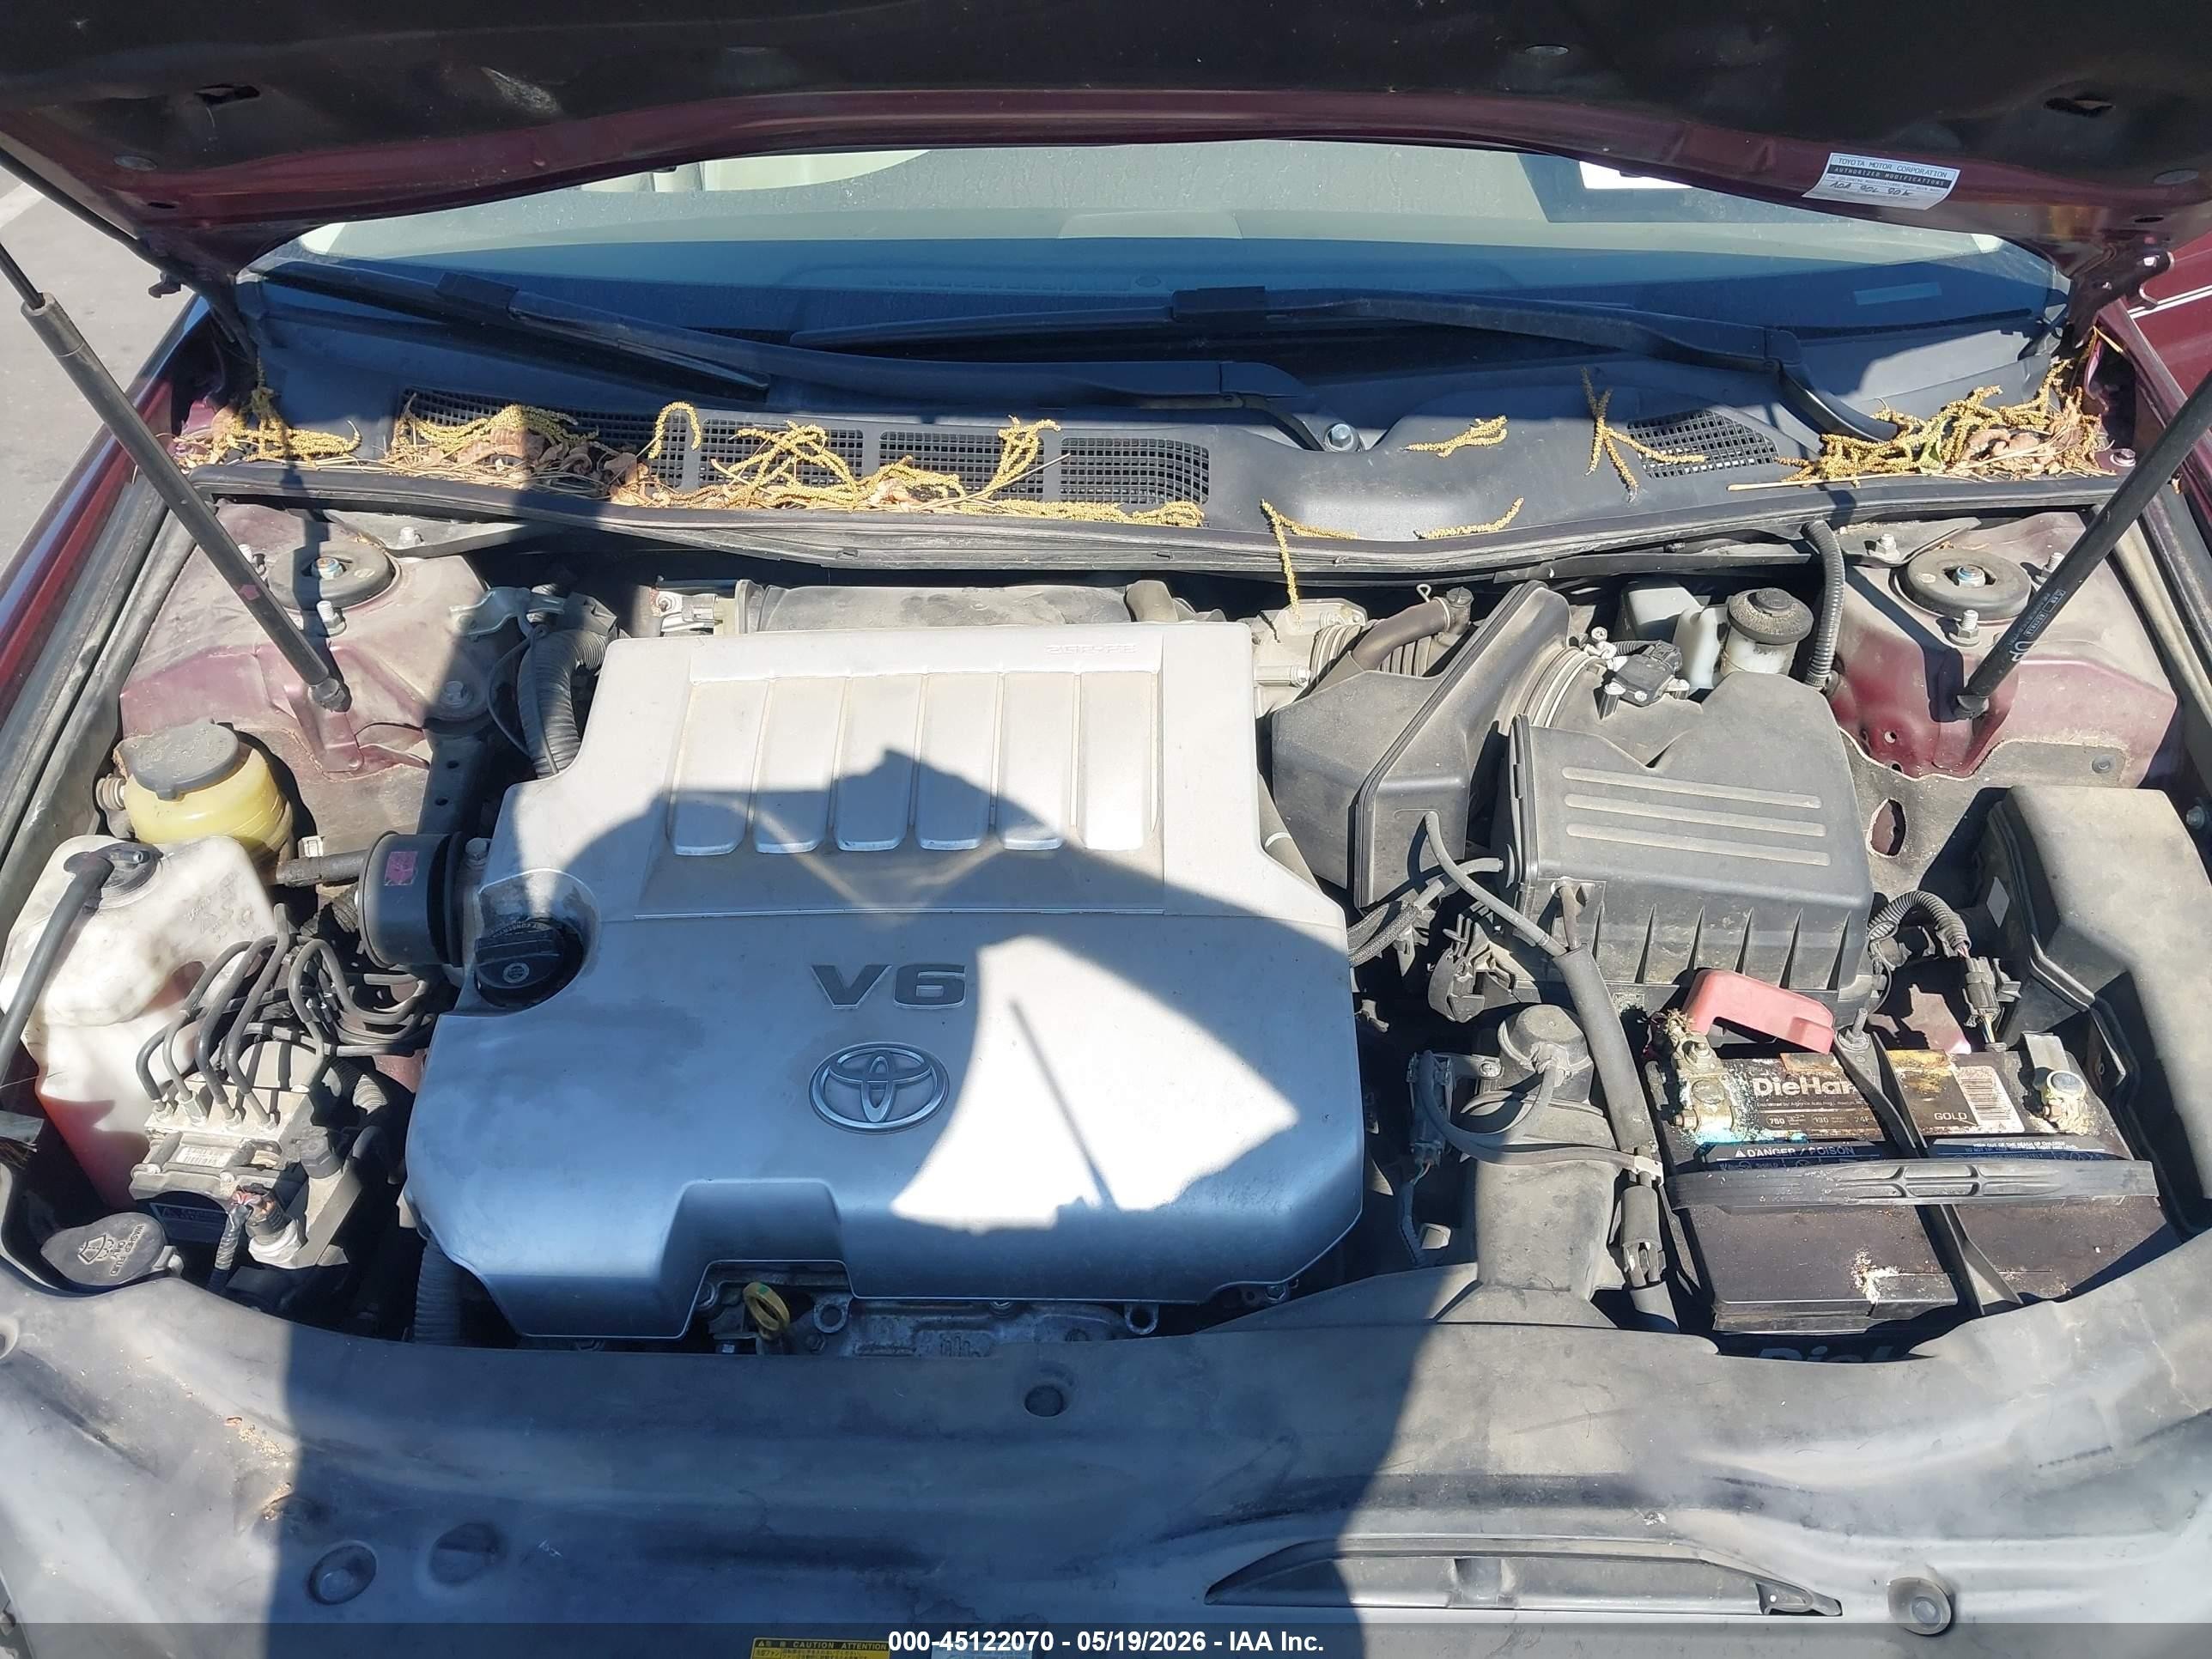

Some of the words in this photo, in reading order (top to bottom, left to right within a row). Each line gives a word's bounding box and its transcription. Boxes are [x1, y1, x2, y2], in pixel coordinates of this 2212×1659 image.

[1834, 167, 1881, 177] AUTHORIZED
[1884, 173, 1945, 186] MODIFICATIONS
[1838, 158, 1865, 167] TOYOTA
[1869, 161, 1893, 170] MOTOR
[1896, 165, 1948, 178] CORPORATION
[810, 963, 968, 1010] V6
[1752, 1075, 1857, 1097] DieHar
[1934, 1112, 1967, 1121] GOLD
[1747, 1146, 1796, 1158] DANGER
[1808, 1146, 1856, 1156] POISON
[793, 1641, 835, 1650] CAUTION
[841, 1642, 888, 1650] ATTENTION
